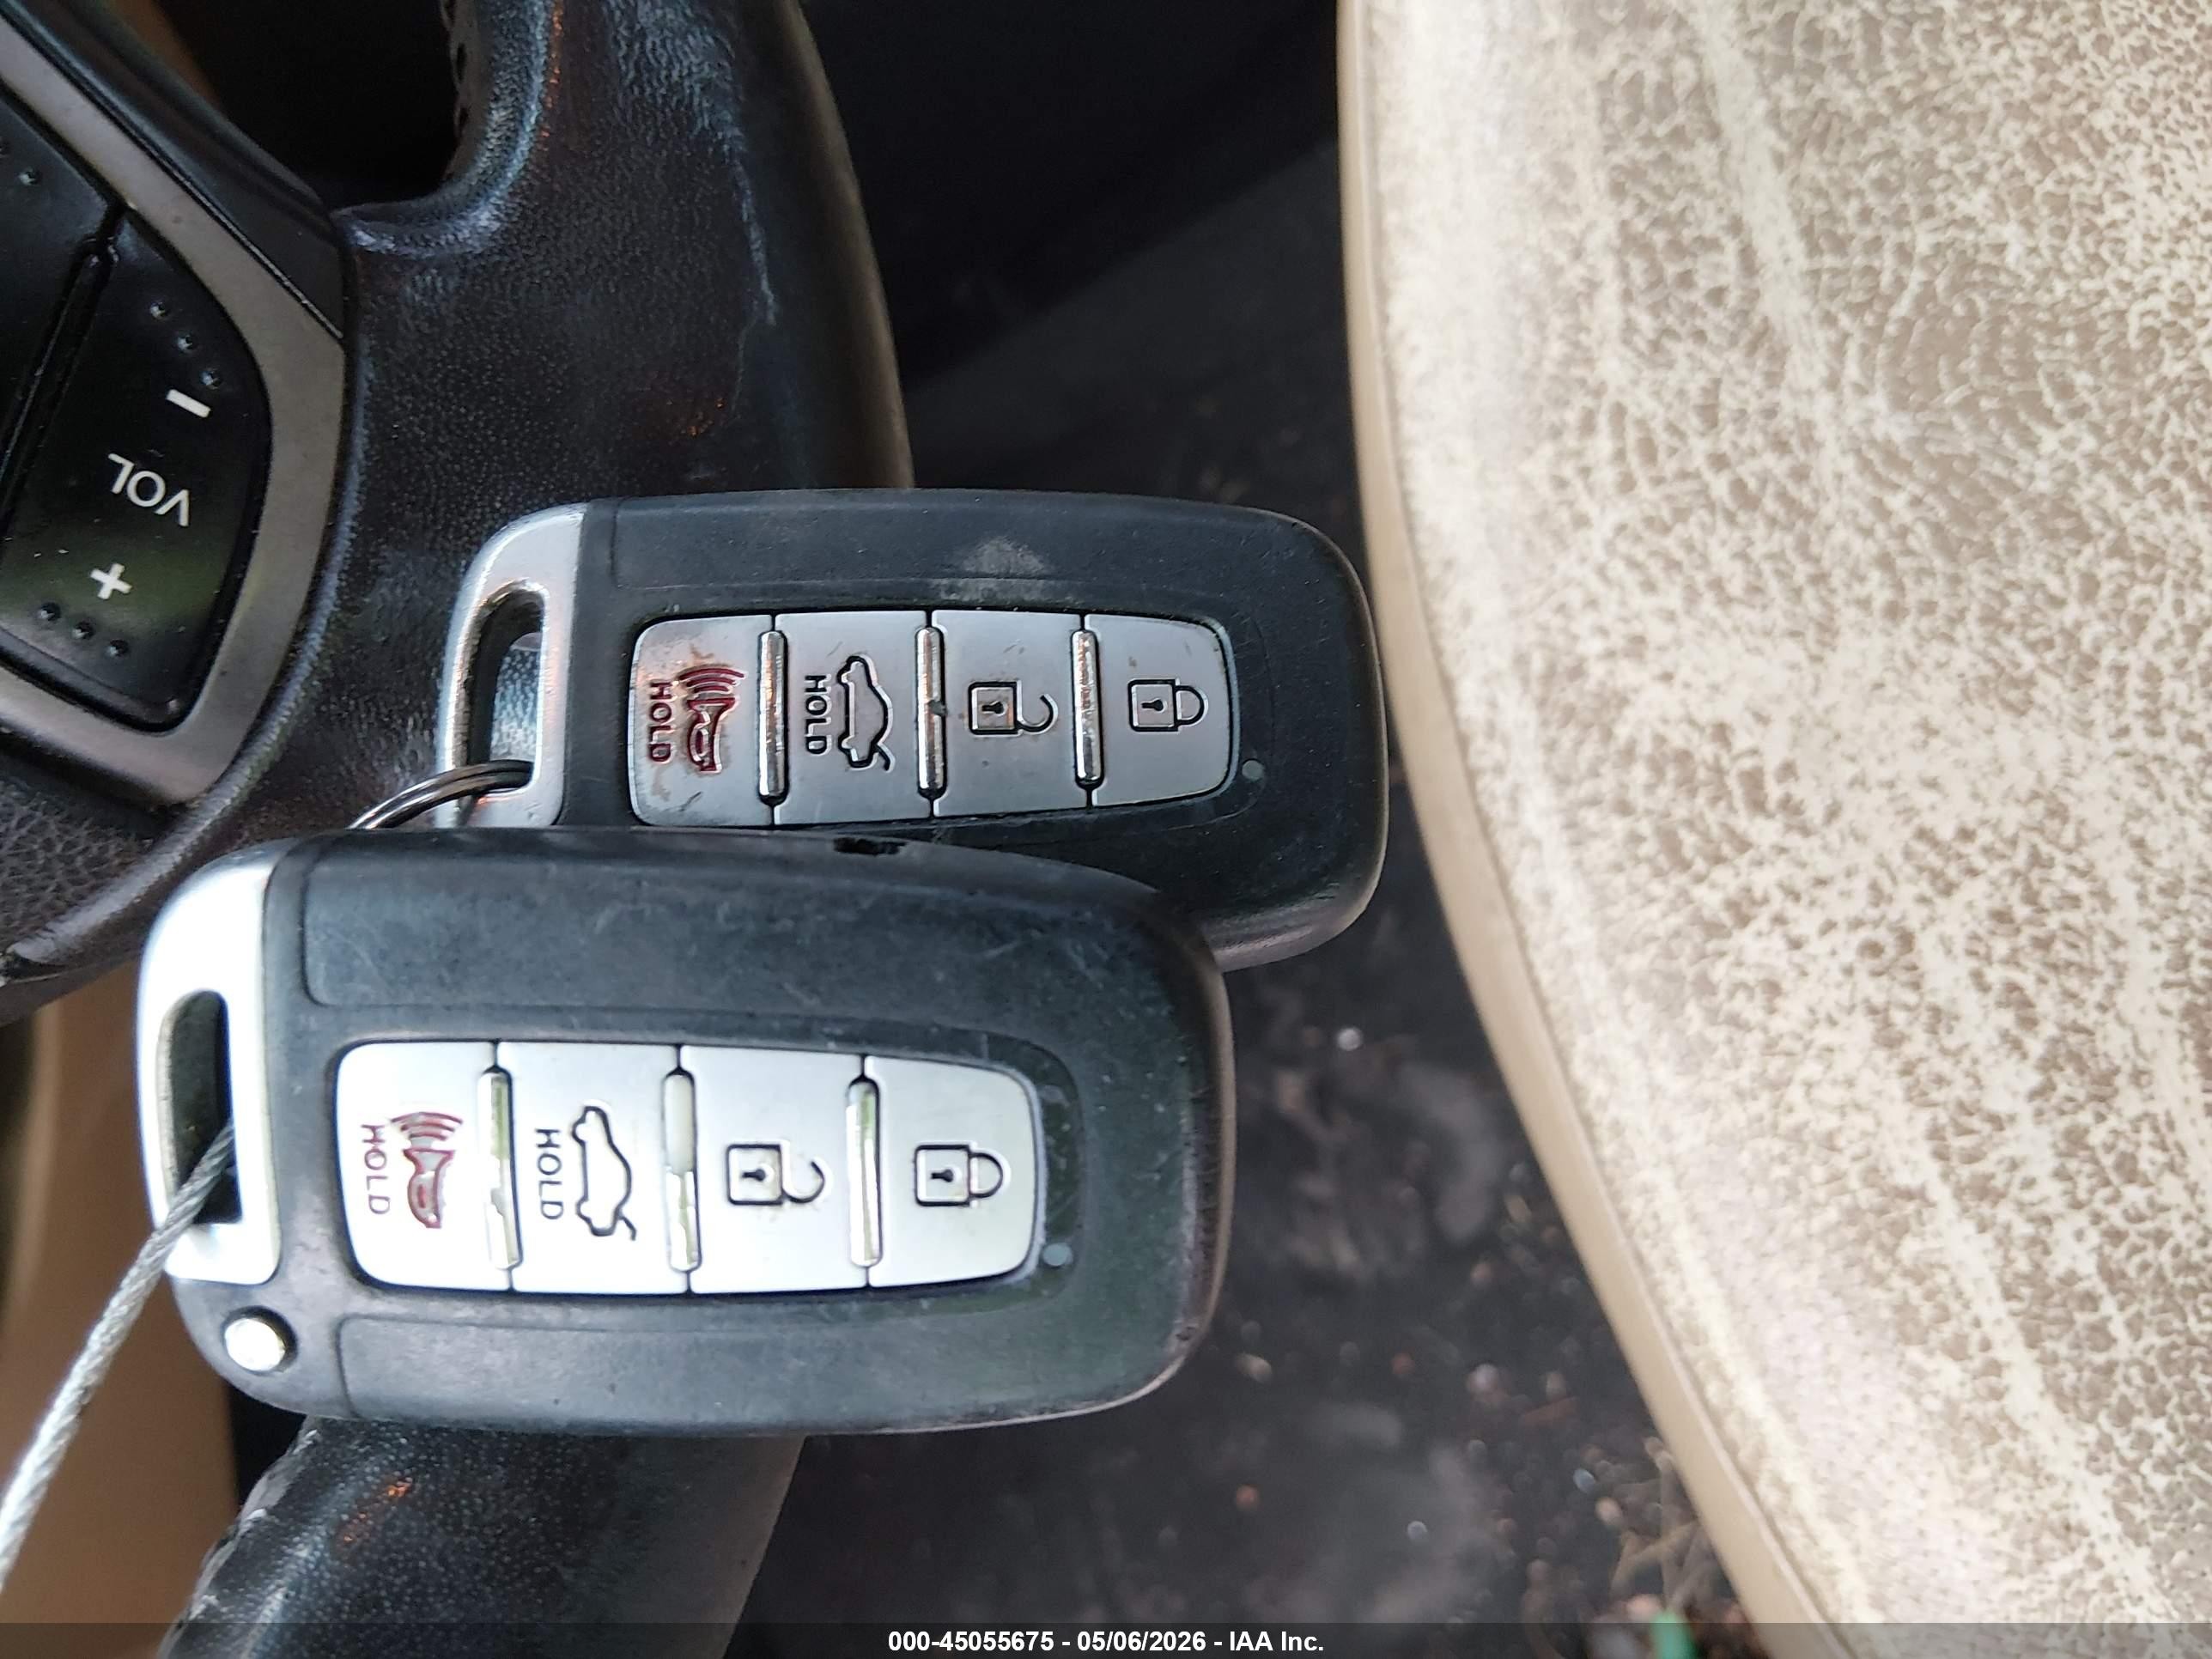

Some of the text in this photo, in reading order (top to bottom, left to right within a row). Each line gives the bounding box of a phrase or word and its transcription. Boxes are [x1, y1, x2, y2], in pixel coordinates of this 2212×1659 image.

[107, 453, 191, 527] VOL
[649, 681, 672, 763] HOLD
[804, 674, 829, 755] HOLD
[360, 1124, 391, 1215] HOLD
[535, 1127, 564, 1220] HOLD
